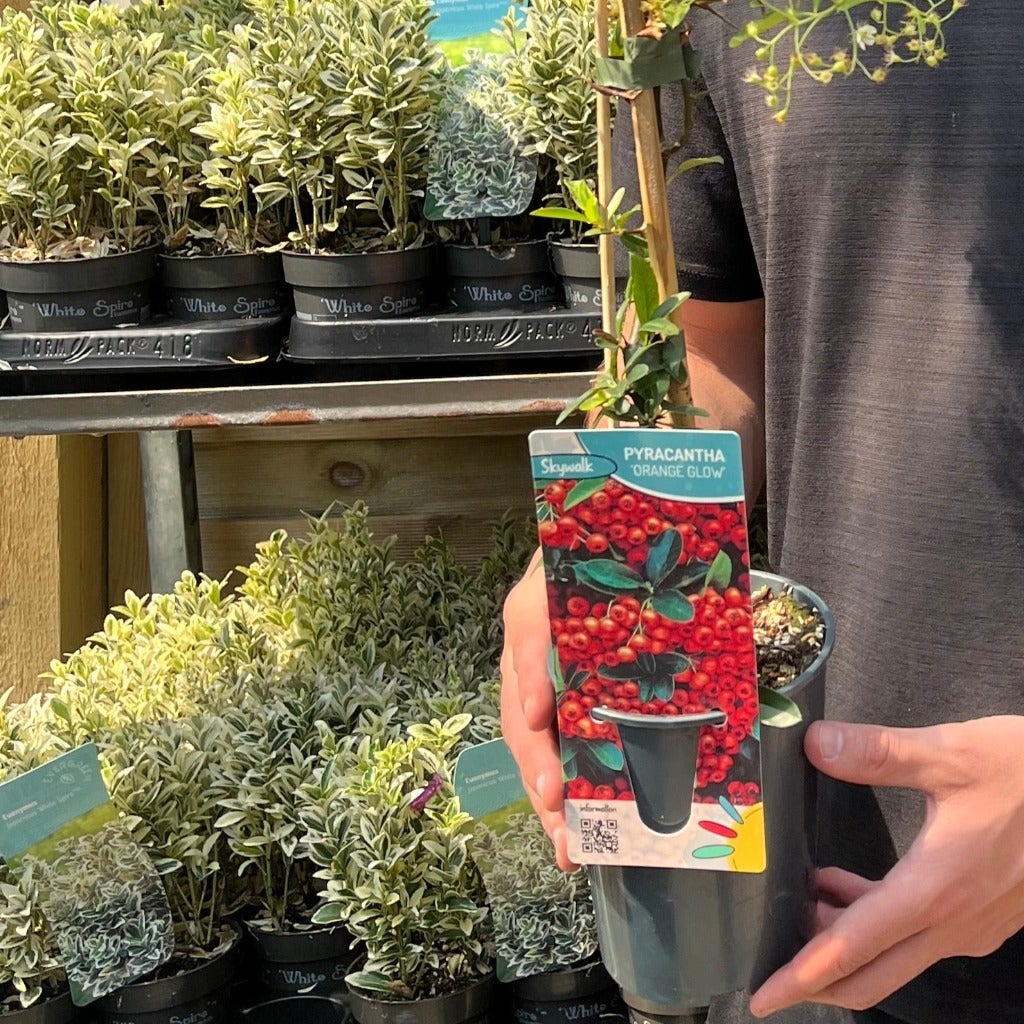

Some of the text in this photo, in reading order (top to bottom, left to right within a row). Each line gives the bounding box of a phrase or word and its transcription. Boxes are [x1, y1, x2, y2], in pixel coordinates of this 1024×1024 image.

[452, 323, 497, 343] NORM
[153, 334, 193, 359] 418
[624, 447, 726, 463] PYRACANTHA
[540, 456, 594, 477] Skywalk
